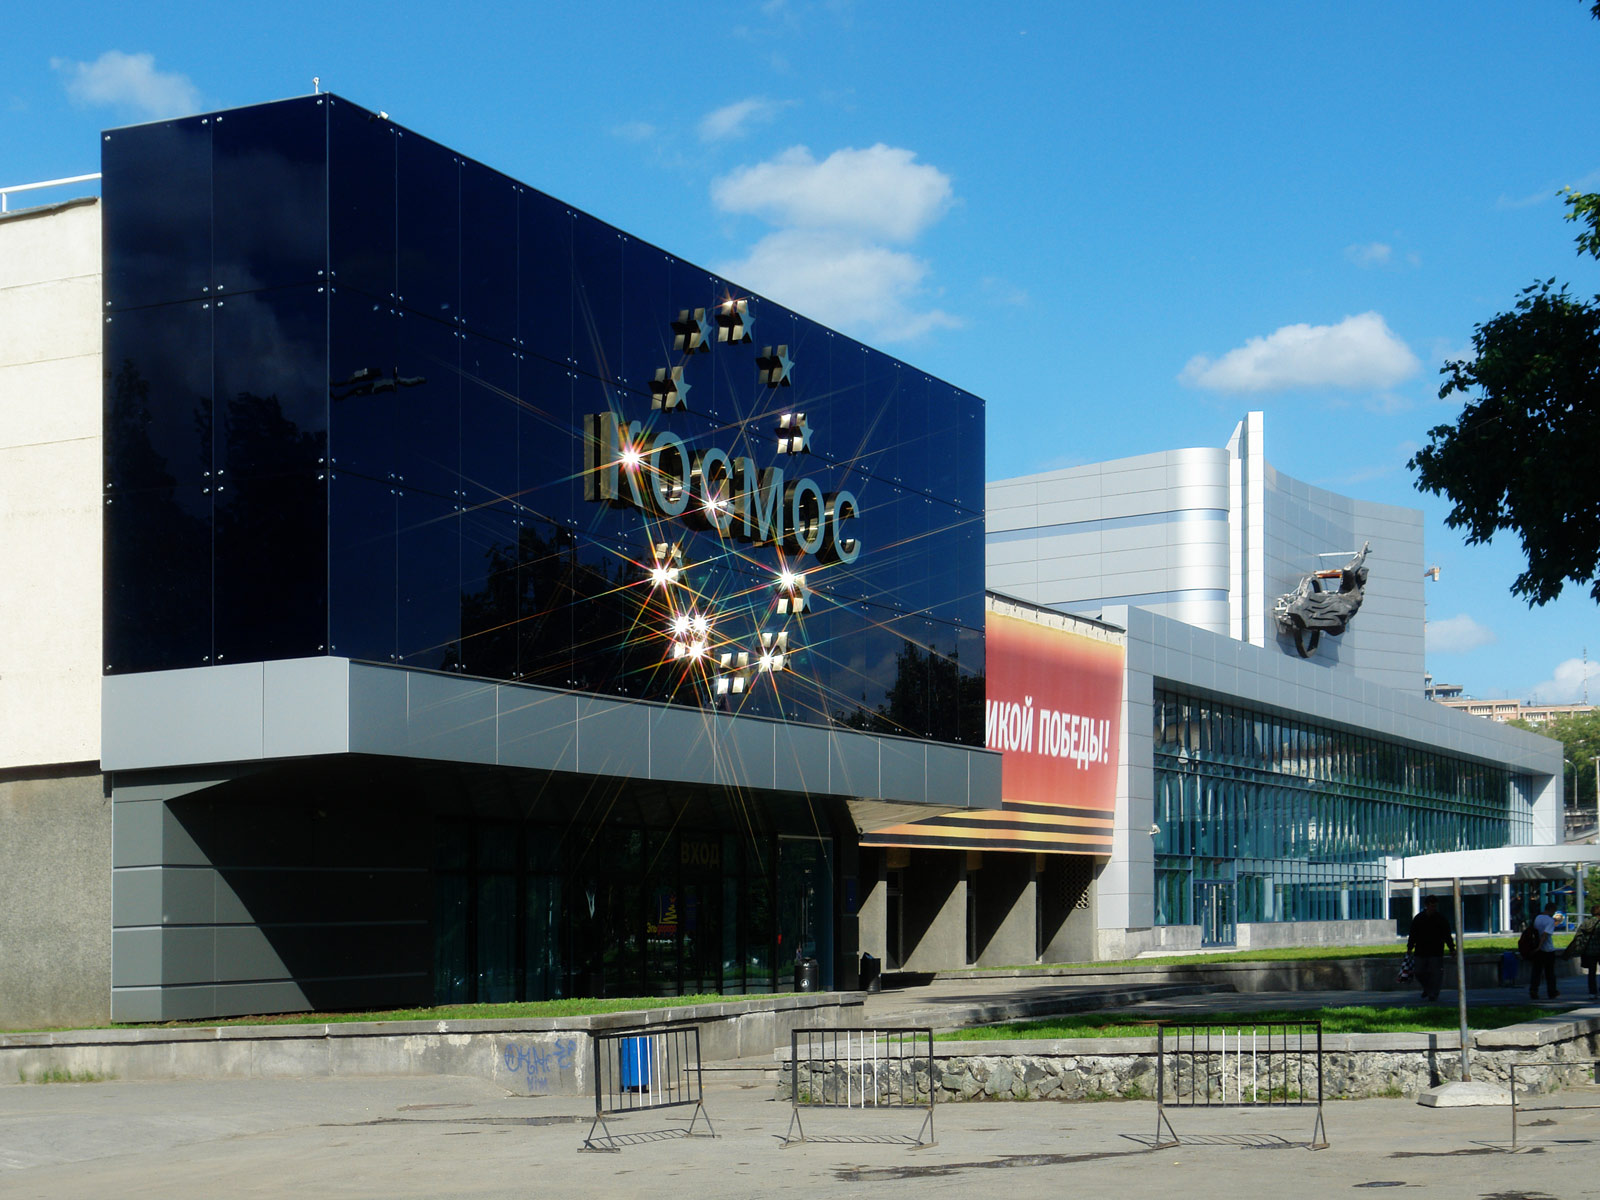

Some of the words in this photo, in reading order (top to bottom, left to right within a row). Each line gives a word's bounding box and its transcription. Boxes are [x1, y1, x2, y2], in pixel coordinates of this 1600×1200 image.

[584, 412, 861, 564] КОСМОС
[985, 695, 1034, 753] ИКОЙ
[1038, 709, 1110, 770] ПОБЕДЫ!
[680, 842, 720, 870] ВХОД
